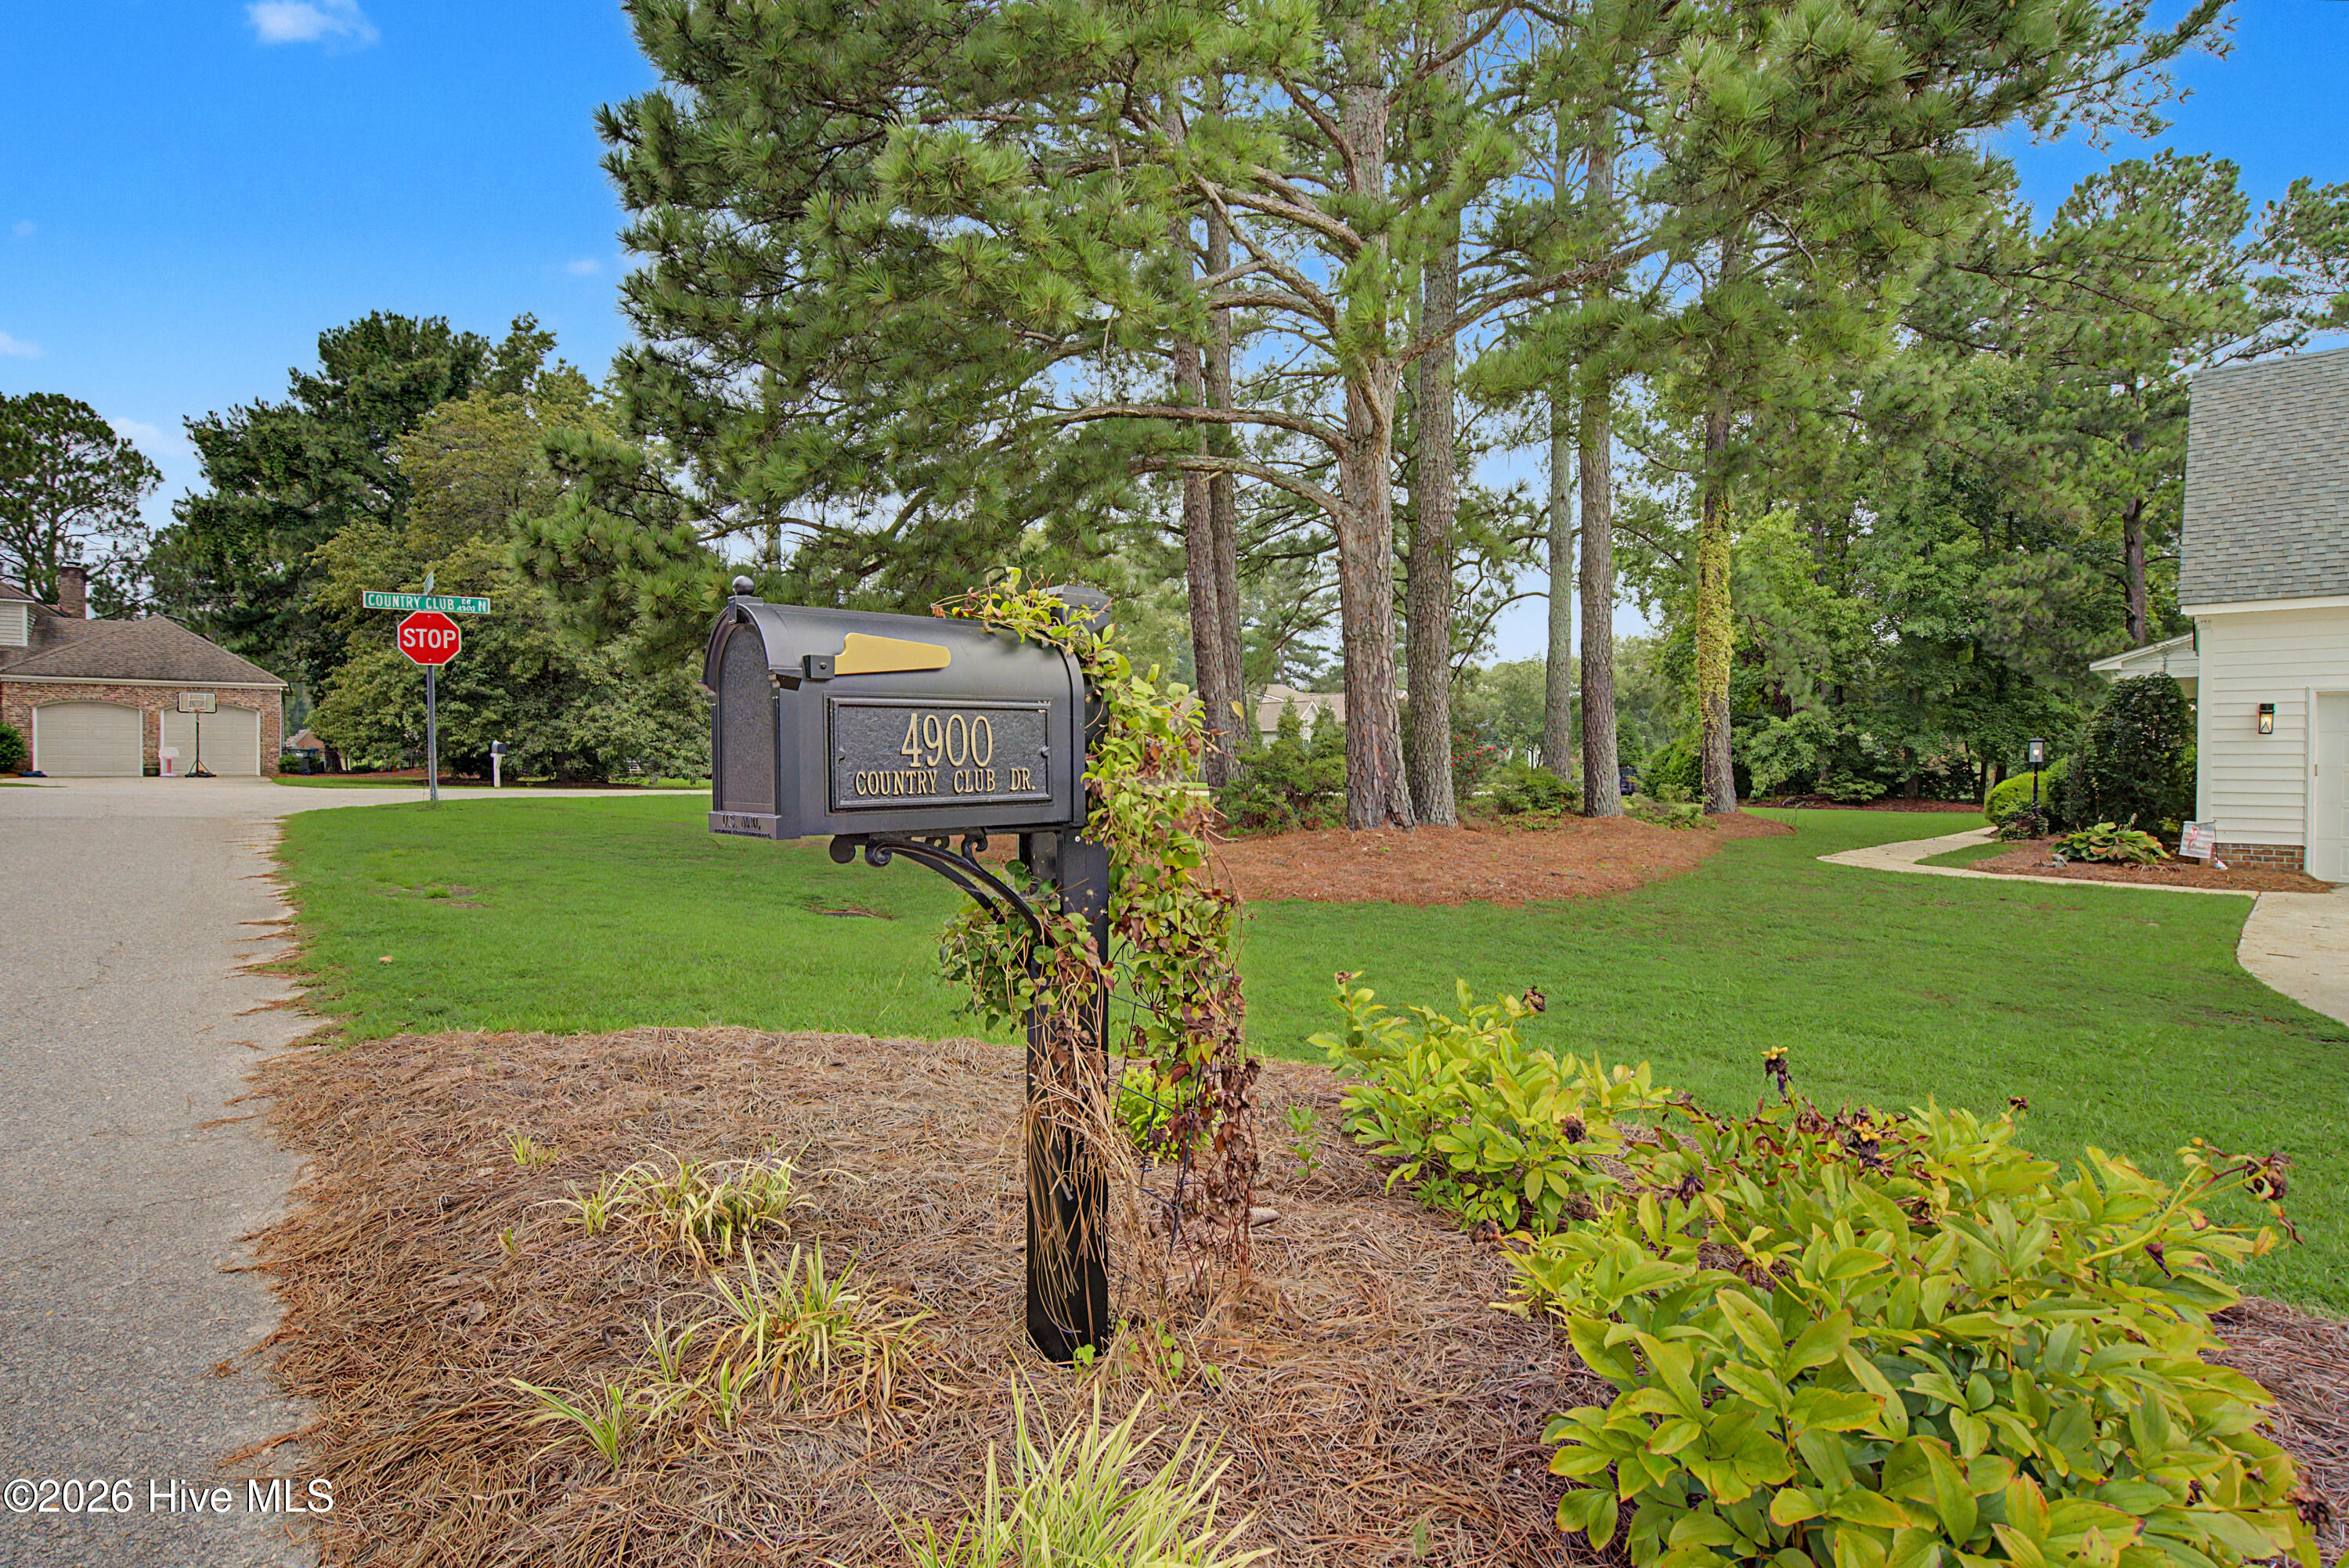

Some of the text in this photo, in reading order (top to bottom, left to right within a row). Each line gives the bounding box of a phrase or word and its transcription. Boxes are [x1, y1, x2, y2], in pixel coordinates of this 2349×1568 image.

[368, 593, 422, 608] COUNTRY
[426, 597, 454, 611] CLUB
[478, 600, 486, 612] N
[402, 628, 456, 649] STOP
[900, 712, 993, 768] 4900
[855, 767, 1037, 796] COUNTRY CLUB DR.
